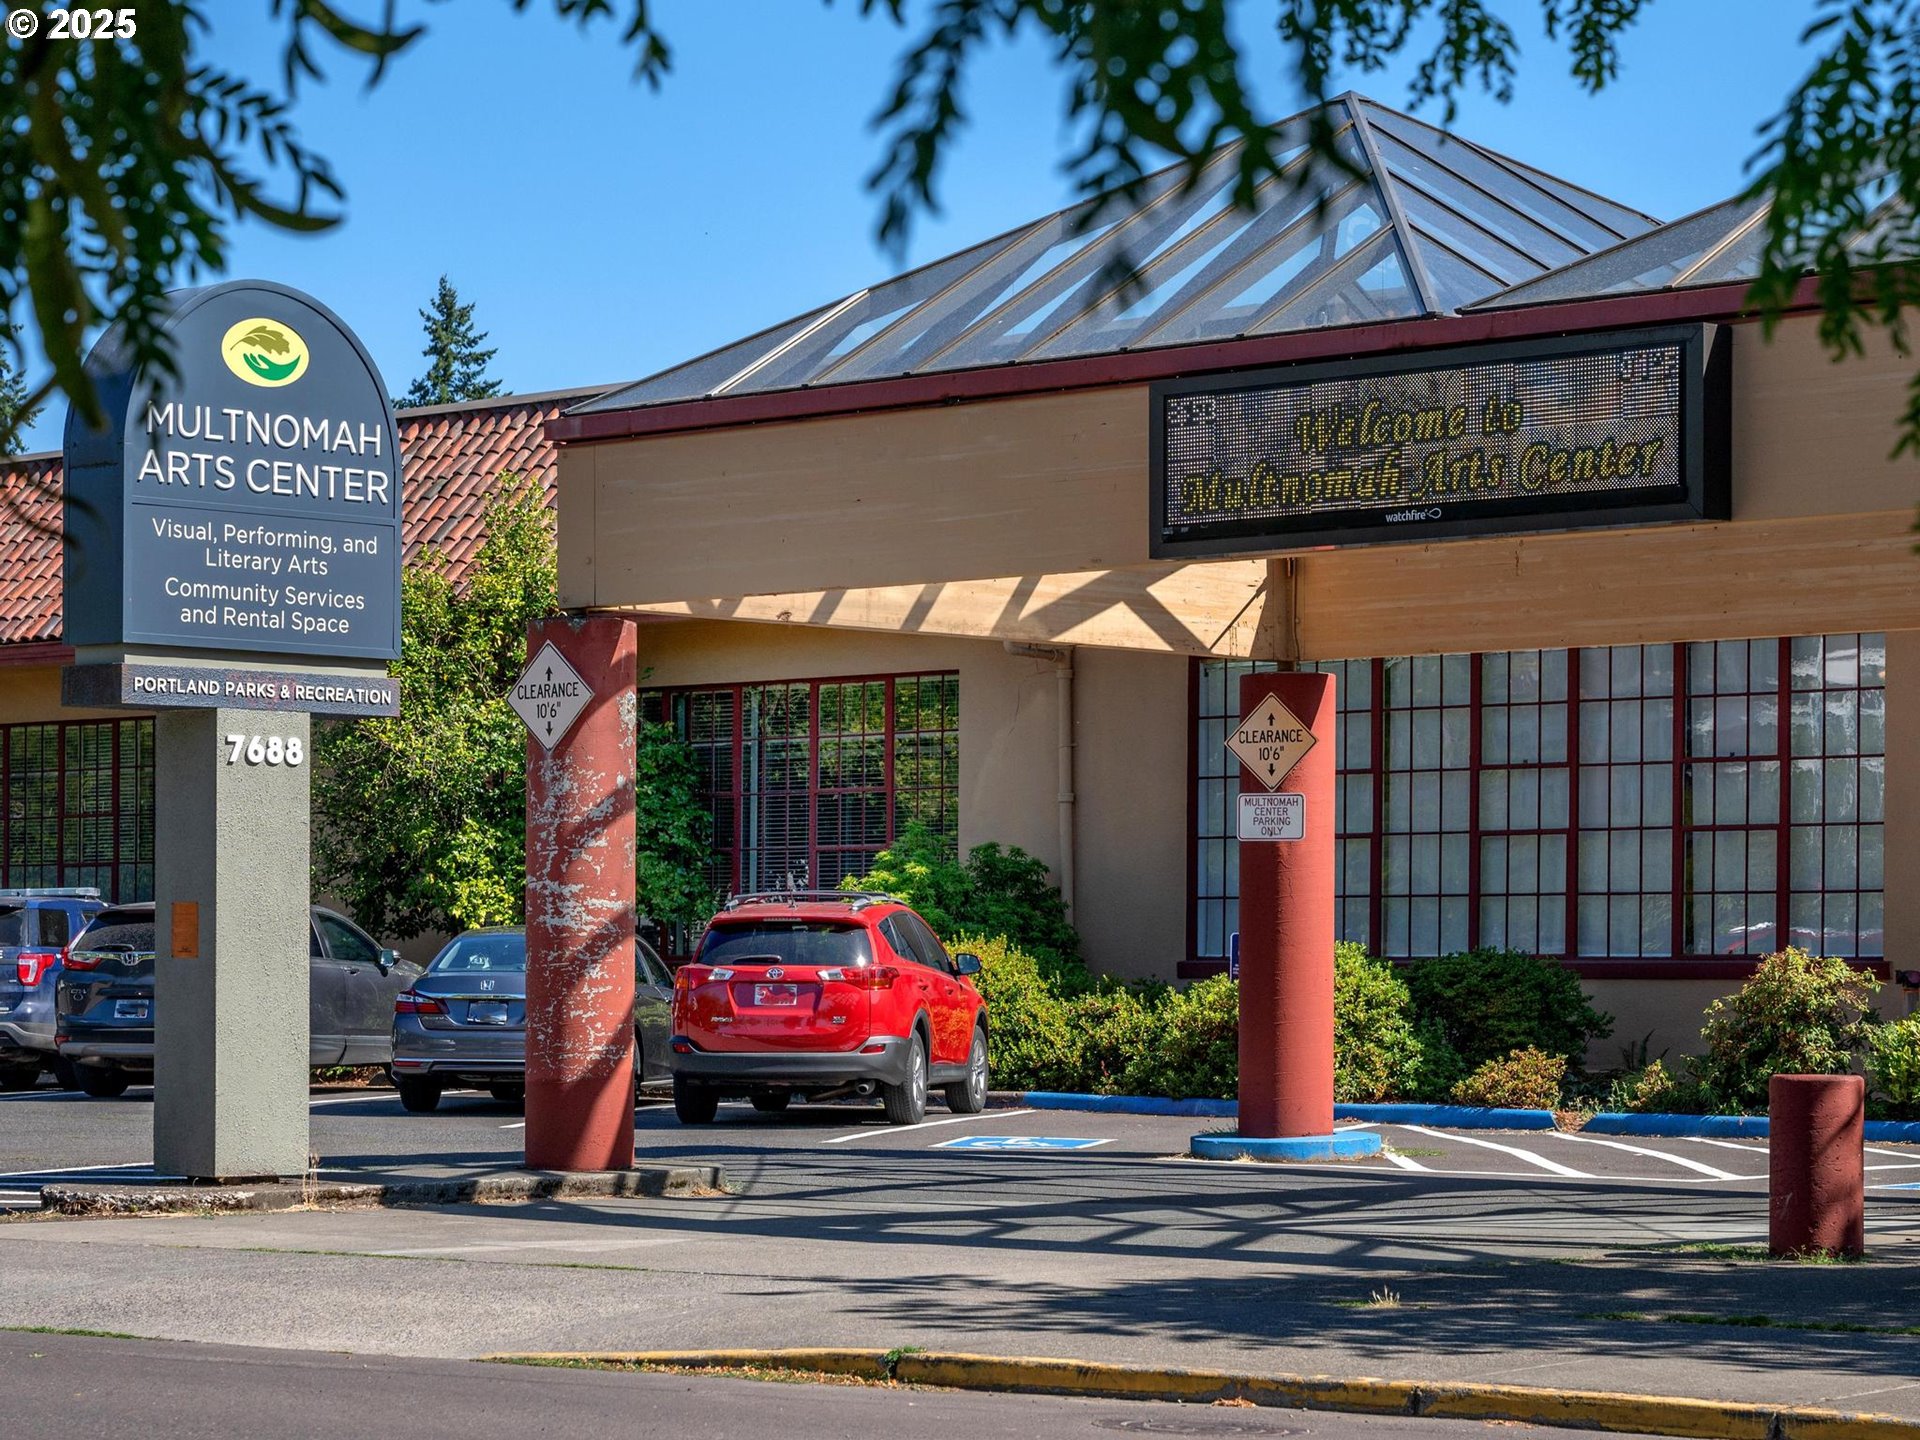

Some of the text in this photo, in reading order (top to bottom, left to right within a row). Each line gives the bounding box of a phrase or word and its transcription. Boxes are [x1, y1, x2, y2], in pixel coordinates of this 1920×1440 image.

[147, 401, 382, 457] MULTNOMAH
[1297, 397, 1521, 451] Welcome to
[137, 449, 389, 504] ARTS CENTER
[1183, 439, 1662, 513] Multnomah Arts Center
[1385, 508, 1426, 523] watchfire
[152, 517, 378, 555] Visual, Performing, and
[205, 548, 328, 576] Literary Arts
[165, 577, 365, 610] Community Services
[180, 605, 350, 635] and Rental Space
[133, 676, 391, 705] PORTLAND PARKS & RECREATION
[517, 682, 579, 699] CLEARANCE
[536, 701, 561, 719] 10'6"
[225, 734, 304, 766] 7688
[1239, 729, 1303, 743] CLEARANCE
[1258, 746, 1285, 761] 10'6"
[1244, 797, 1299, 807] MULTNOMAH
[1254, 807, 1289, 816] CENTER
[1252, 816, 1291, 827] PARKING
[1261, 826, 1283, 836] ONLY
